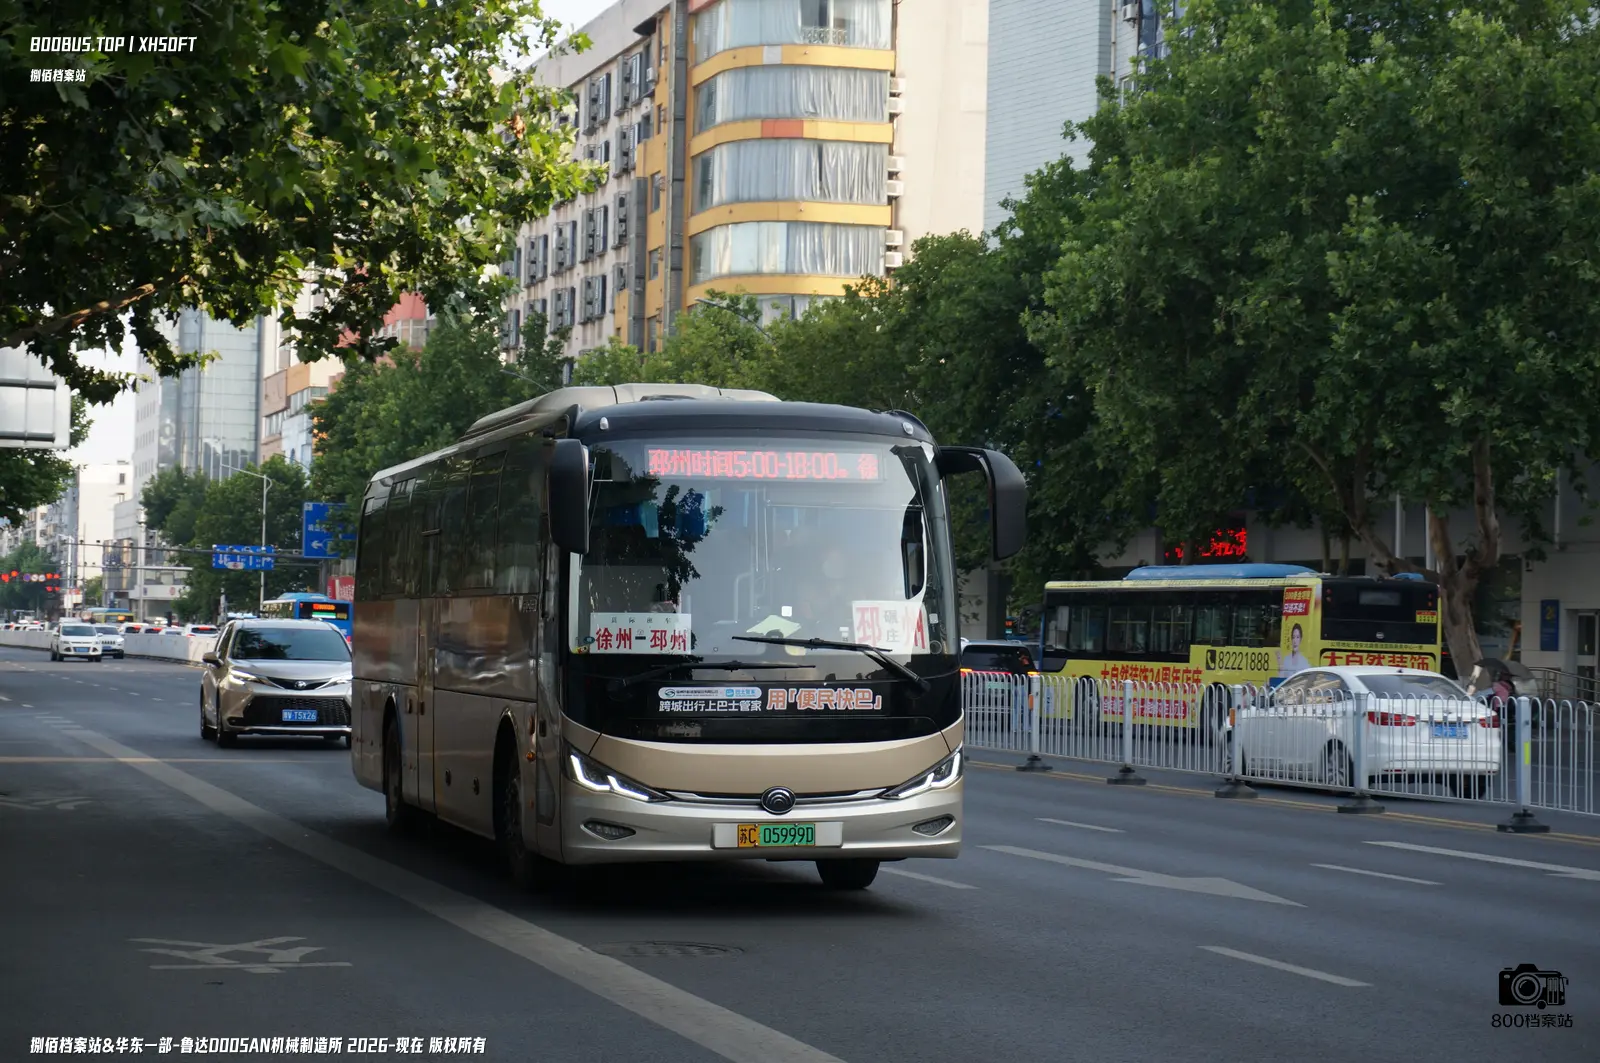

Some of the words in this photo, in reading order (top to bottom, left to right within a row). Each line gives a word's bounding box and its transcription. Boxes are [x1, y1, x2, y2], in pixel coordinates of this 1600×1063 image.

[1218, 651, 1270, 672] 82221888
[1322, 651, 1430, 671] 大自然装饰
[659, 700, 762, 712] 跨城出行上巴士管家
